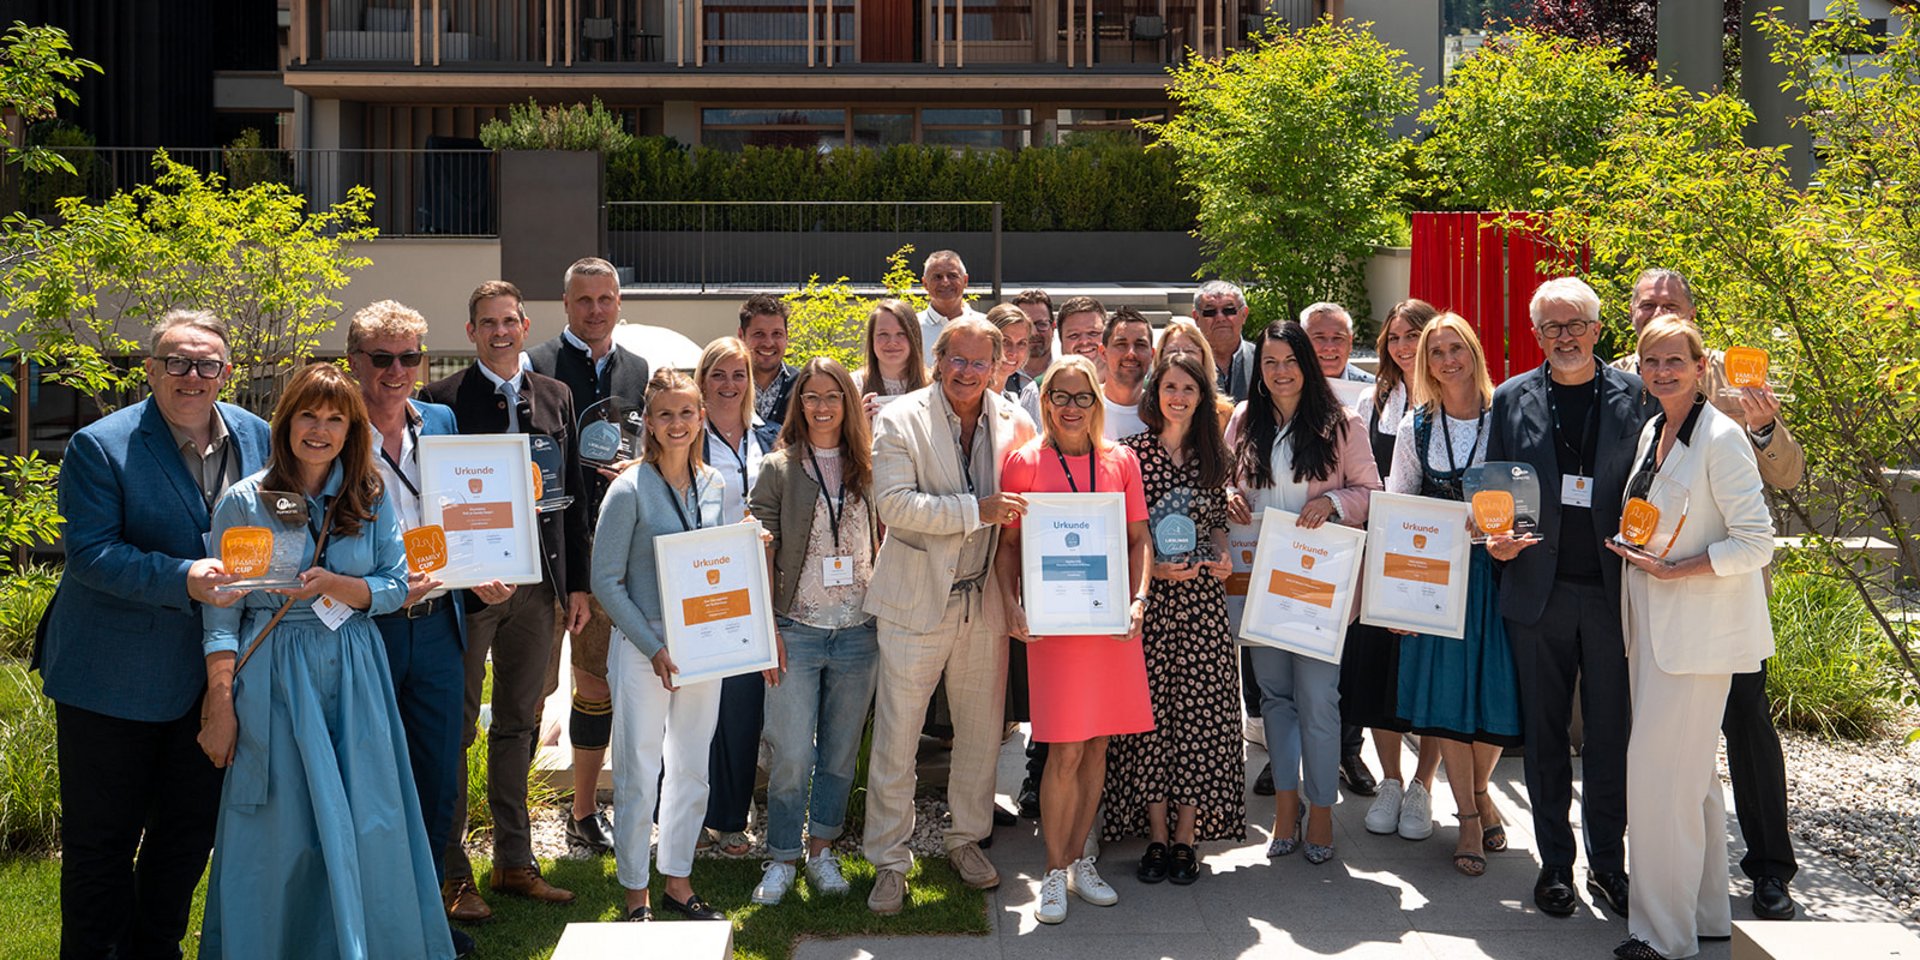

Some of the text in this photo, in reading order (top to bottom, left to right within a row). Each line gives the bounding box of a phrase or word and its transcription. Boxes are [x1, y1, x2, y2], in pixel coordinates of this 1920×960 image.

[454, 466, 494, 476] Urkunde
[1053, 521, 1090, 529] Urkunde
[1402, 521, 1439, 534] Urkunde
[1625, 530, 1638, 538] CUP
[1231, 540, 1257, 548] Urkund
[1292, 540, 1329, 557] Urkunde
[417, 552, 441, 563] FAMILY
[693, 556, 731, 569] Urkunde
[234, 566, 253, 574] CUP
[418, 560, 434, 570] CUP
